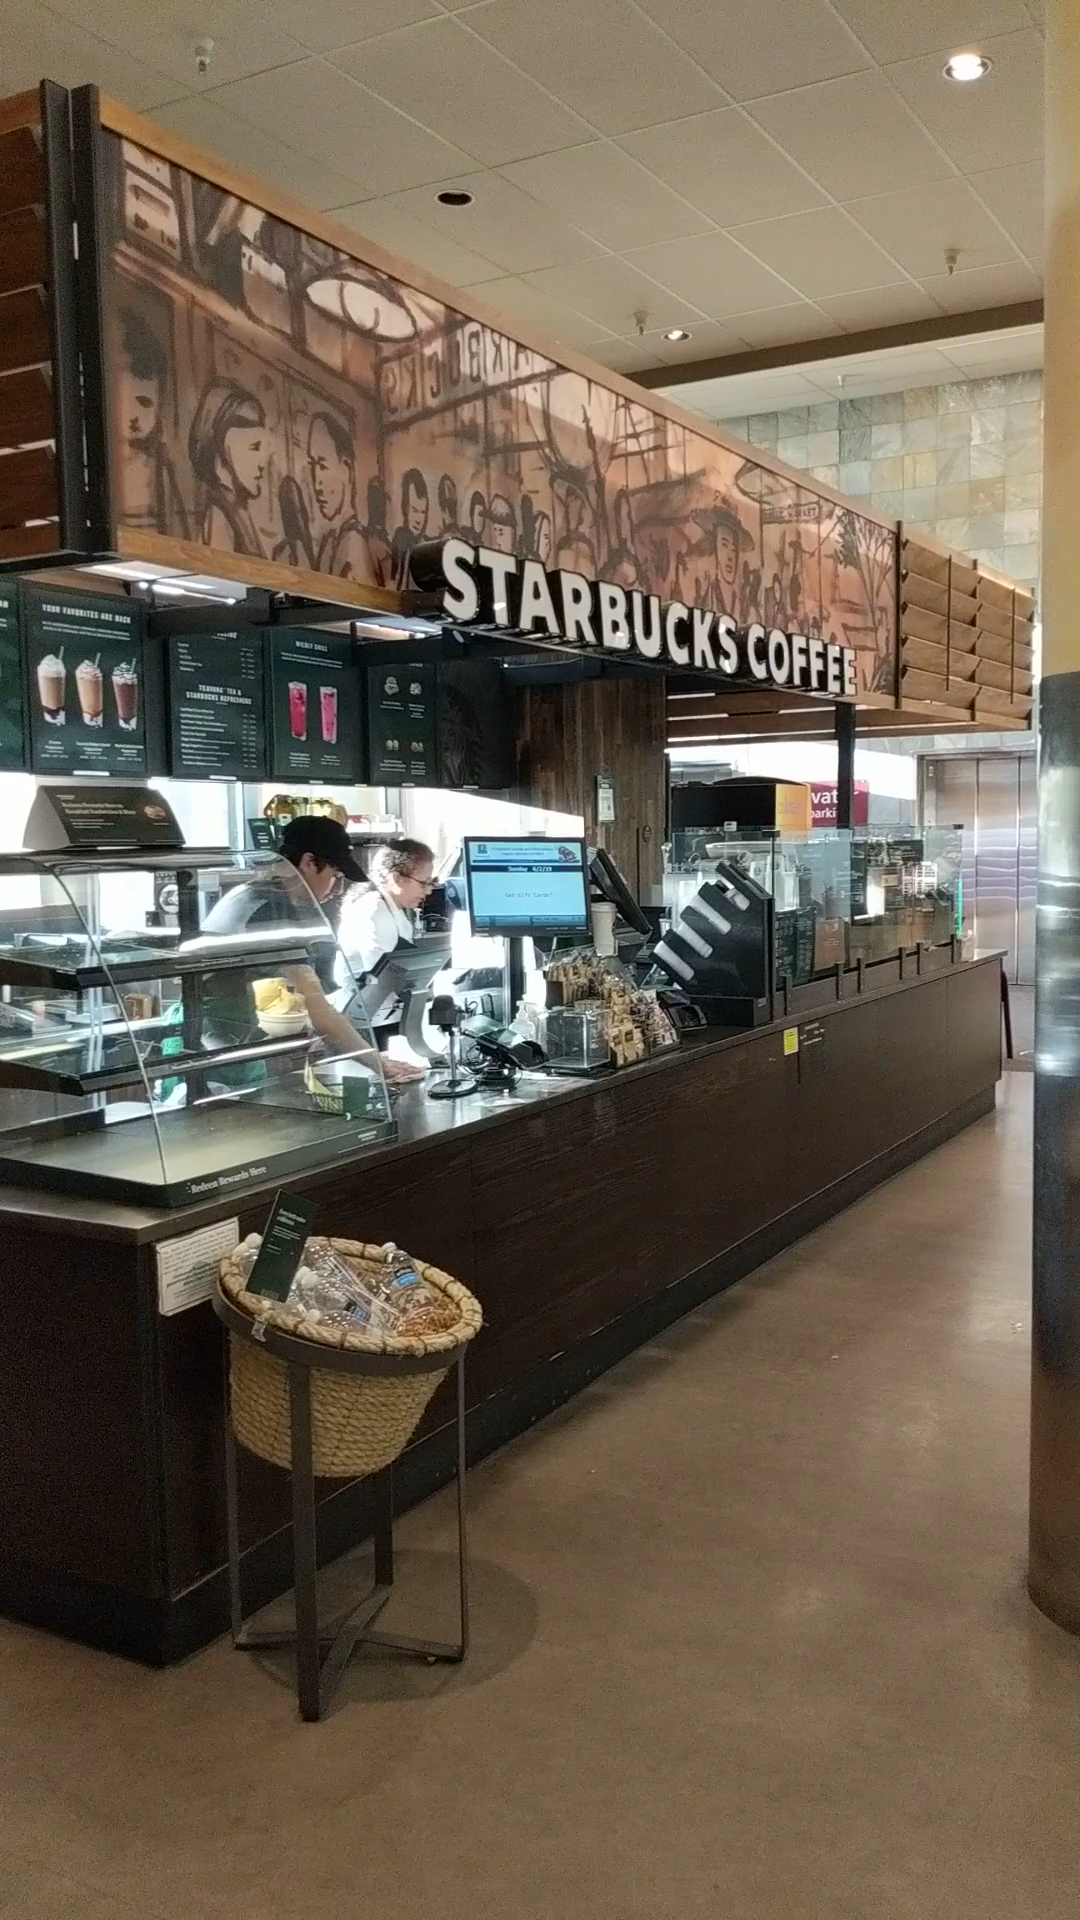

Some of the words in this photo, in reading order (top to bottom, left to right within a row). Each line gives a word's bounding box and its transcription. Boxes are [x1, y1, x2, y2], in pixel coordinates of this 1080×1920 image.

[62, 606, 99, 619] FAVORITES
[441, 537, 738, 675] STARBUCKS
[747, 623, 857, 696] COFFEE
[507, 865, 529, 873] Sunday
[218, 1170, 249, 1186] Rewards
[249, 1165, 268, 1177] Here
